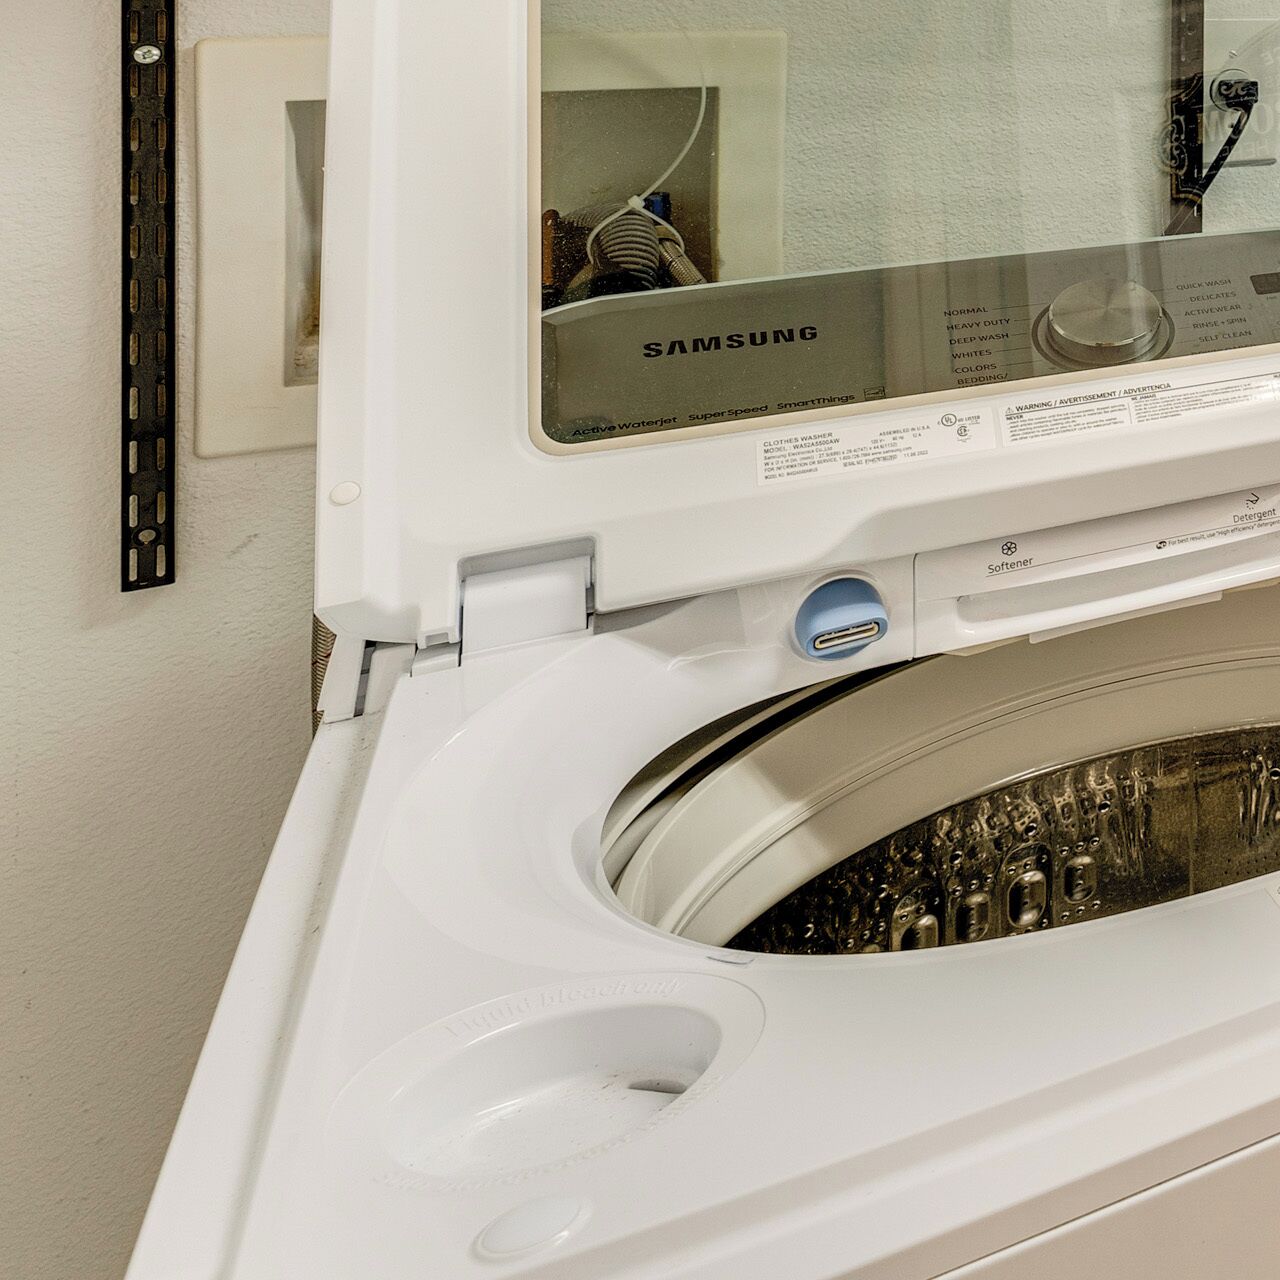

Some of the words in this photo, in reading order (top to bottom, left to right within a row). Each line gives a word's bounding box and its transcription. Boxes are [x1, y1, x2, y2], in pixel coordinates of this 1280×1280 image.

[1176, 282, 1204, 291] QUICK
[1204, 279, 1232, 287] WASH
[1189, 291, 1237, 303] DELICATES
[944, 307, 988, 317] NORMAL
[1184, 304, 1242, 317] ACTIVEWEAR
[946, 321, 981, 331] HEAVY
[983, 318, 1010, 327] DUTY
[1192, 320, 1220, 330] RINSE
[1226, 317, 1247, 325] SPIN
[643, 326, 818, 358] SAMSUNG
[949, 336, 976, 345] DEEP
[978, 332, 1009, 341] WASH
[1198, 335, 1219, 343] SELF
[1222, 330, 1252, 340] CLEAN
[951, 349, 992, 359] WHITES
[954, 363, 997, 374] COLORS
[1015, 400, 1053, 412] WARNING
[1059, 391, 1117, 405] AVERTISSEMENT
[1123, 382, 1172, 396] ADVERTENCIA
[571, 423, 618, 438] Active
[617, 416, 678, 432] Waterjet
[688, 409, 727, 422] Super
[727, 404, 769, 418] Speed
[777, 392, 856, 410] SmartThings
[763, 436, 799, 447] CLOTHES
[800, 432, 833, 442] WASHER
[1232, 508, 1277, 524] Detergent
[1177, 537, 1189, 545] best
[1256, 519, 1280, 529] detergent
[987, 557, 1034, 574] Softener
[538, 982, 626, 1008] bleach
